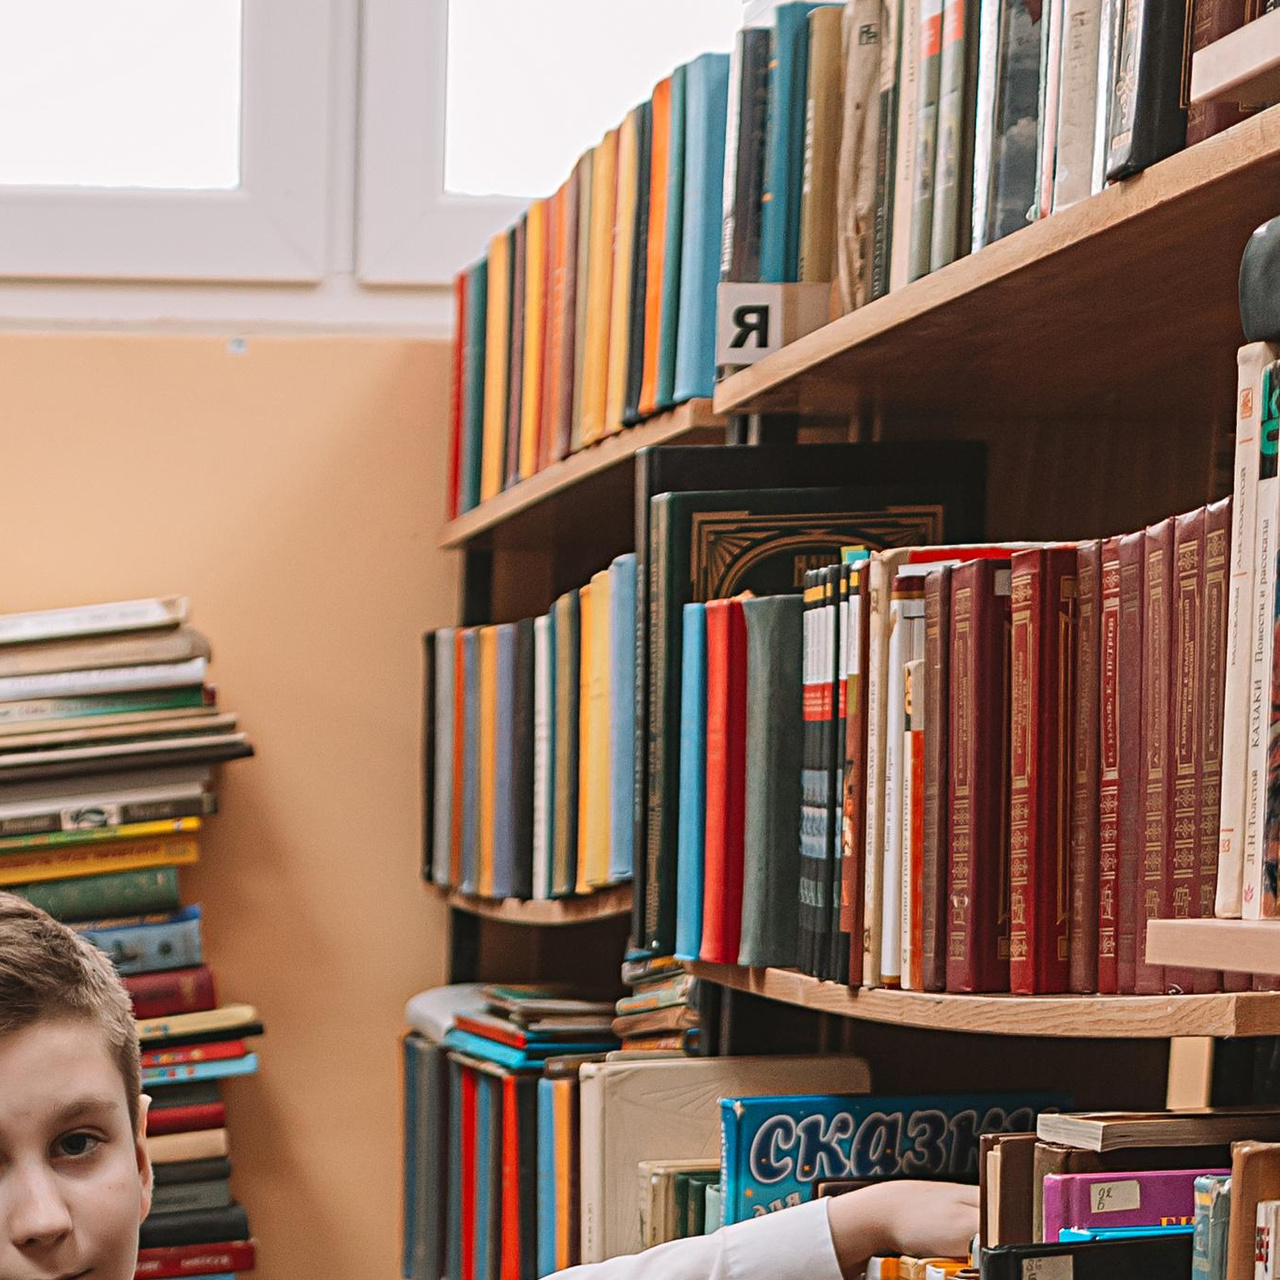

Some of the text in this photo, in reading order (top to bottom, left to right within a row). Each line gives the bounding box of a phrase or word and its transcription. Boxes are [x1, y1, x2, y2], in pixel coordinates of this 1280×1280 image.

[729, 303, 770, 349] Я
[1258, 518, 1273, 586] рассказы
[1105, 616, 1116, 677] ПЕТРОВ
[1252, 602, 1267, 664] Повести
[1250, 679, 1263, 749] КАЗАКИ
